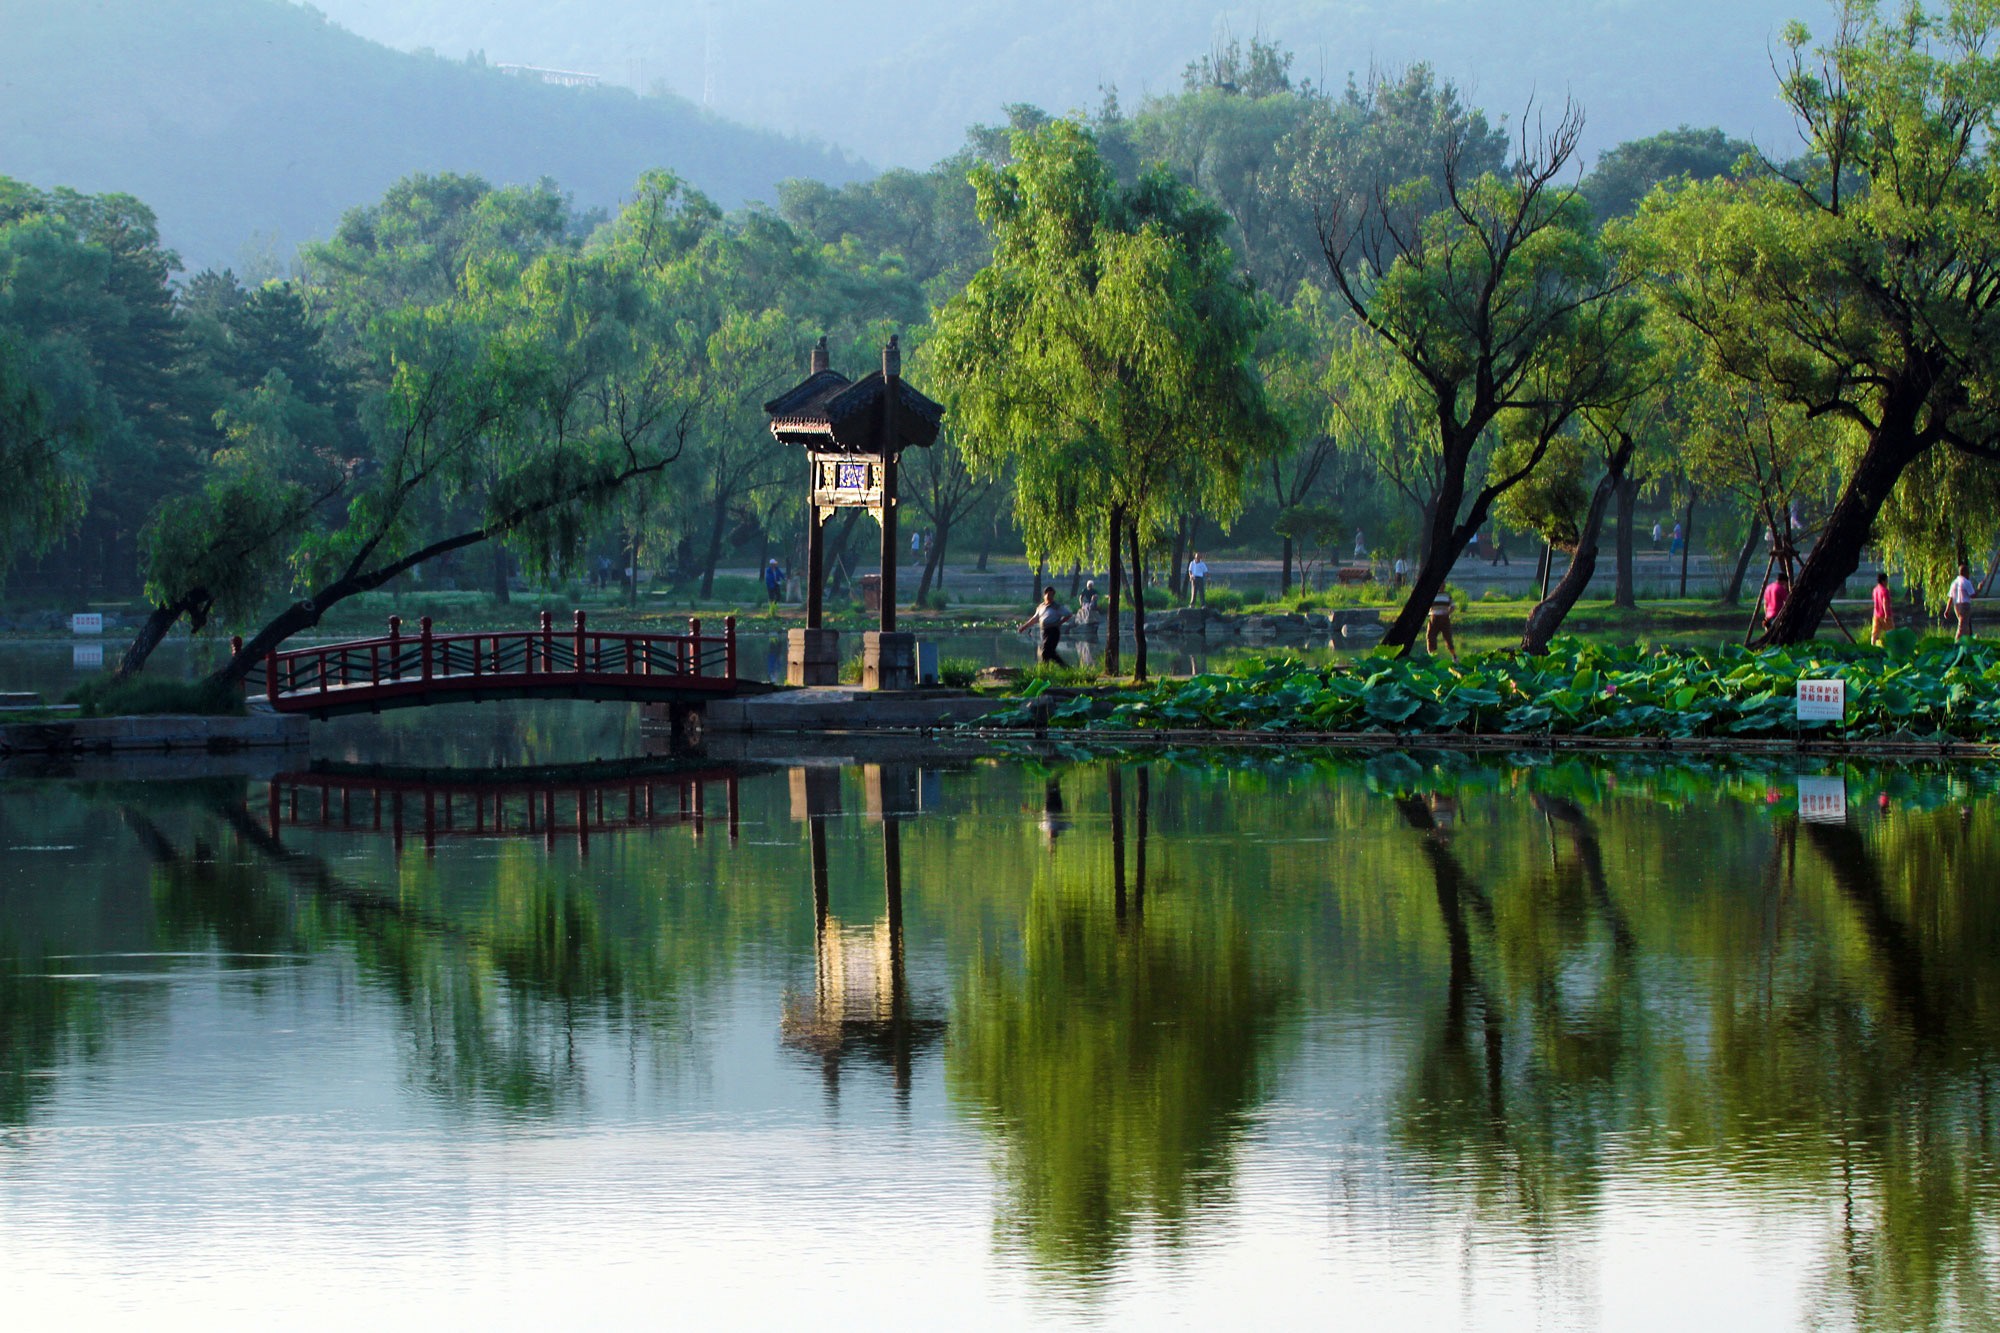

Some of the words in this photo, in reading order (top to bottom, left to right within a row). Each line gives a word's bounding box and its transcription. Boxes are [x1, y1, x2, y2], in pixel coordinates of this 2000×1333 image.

[1800, 685, 1839, 694] 荷花保护区
